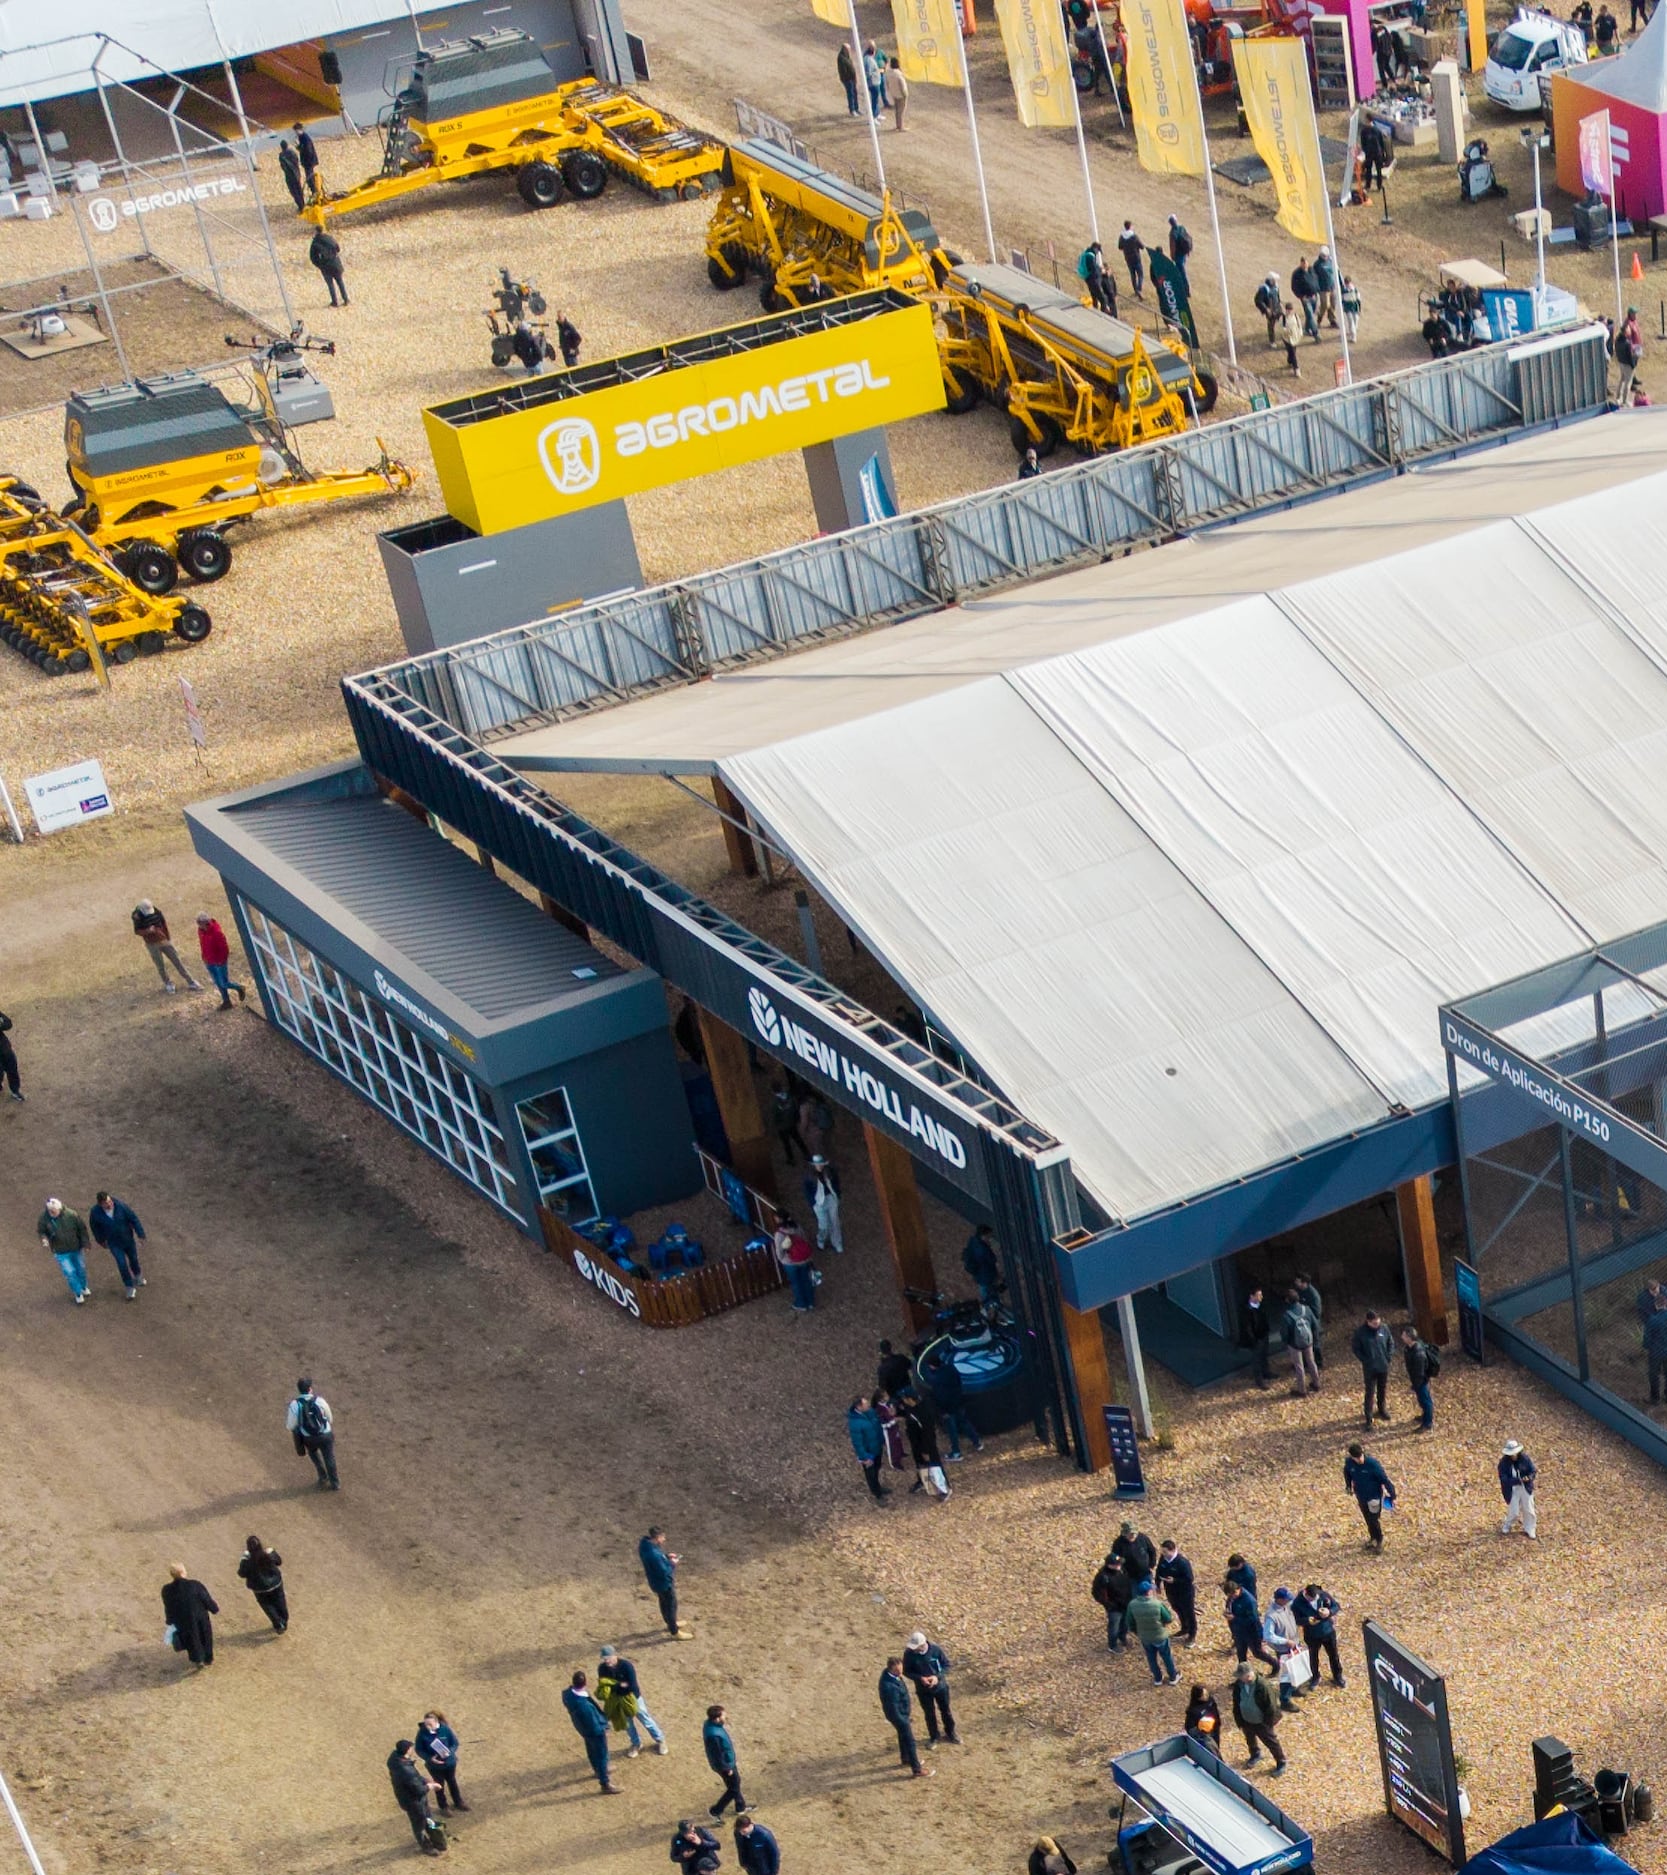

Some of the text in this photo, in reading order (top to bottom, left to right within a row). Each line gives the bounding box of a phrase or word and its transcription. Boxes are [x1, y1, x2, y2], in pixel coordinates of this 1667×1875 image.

[782, 1015, 966, 1169] NEW HOLLAND
[1446, 1022, 1611, 1142] Dron de Aplicación P150
[593, 1263, 641, 1318] KIDS
